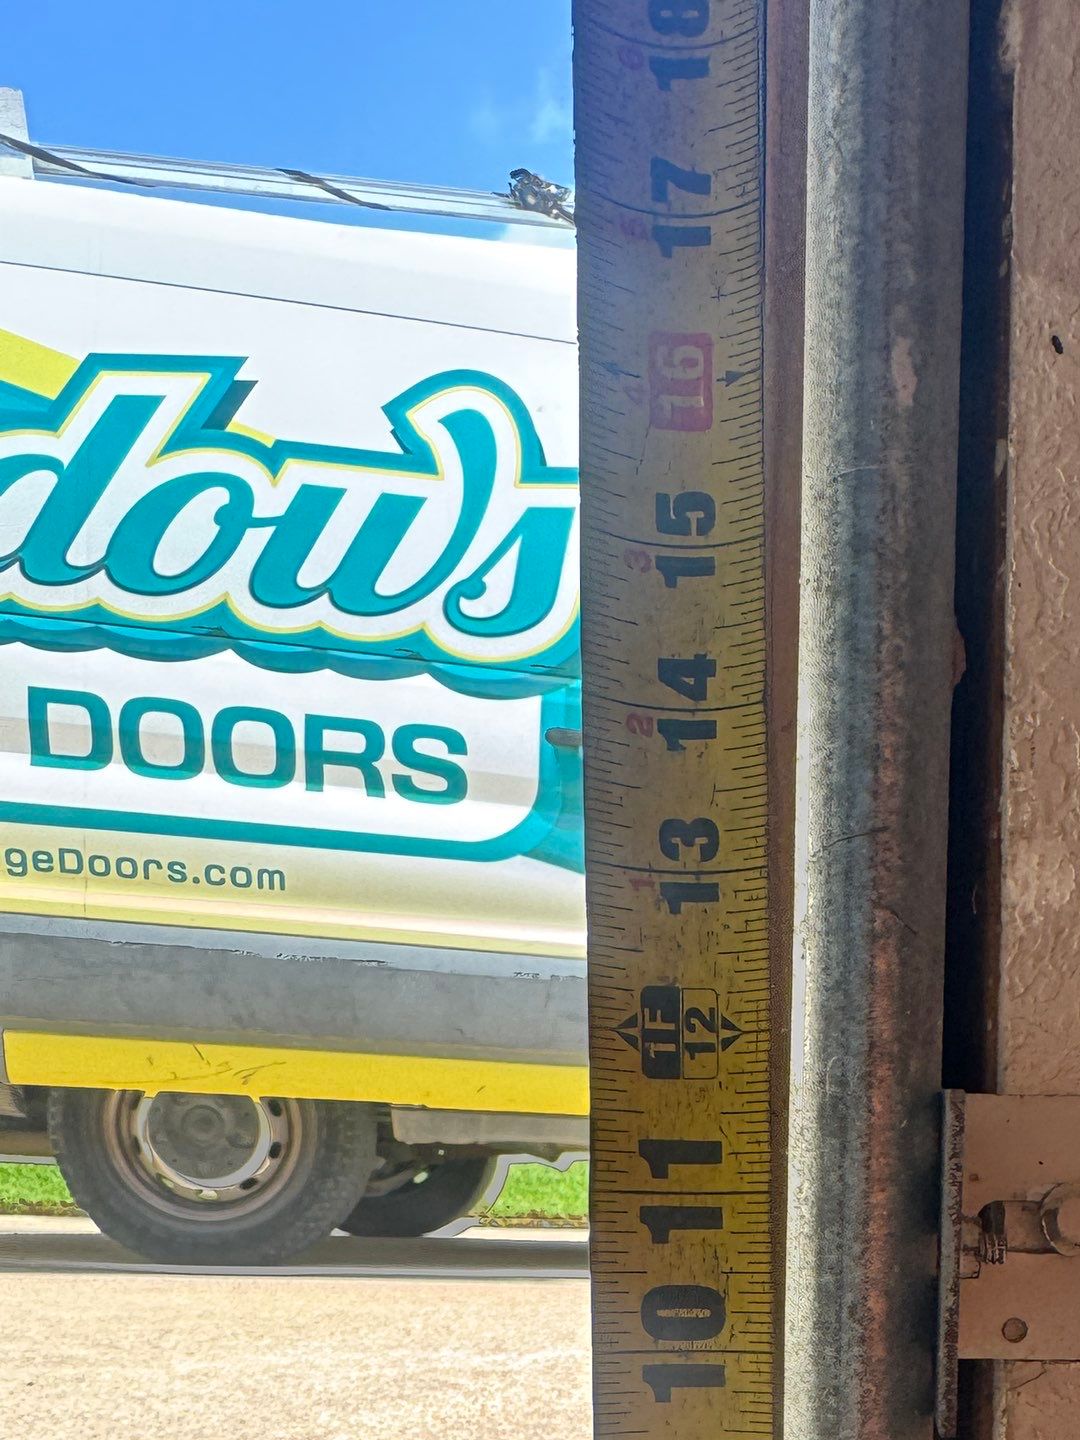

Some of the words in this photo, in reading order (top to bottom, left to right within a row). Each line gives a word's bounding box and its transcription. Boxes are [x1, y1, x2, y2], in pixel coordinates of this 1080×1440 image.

[647, 0, 711, 92] 18
[650, 155, 712, 259] 17
[655, 343, 706, 409] 16
[655, 491, 716, 588] 15
[27, 685, 469, 806] DOORS
[657, 653, 718, 752] 14
[4, 846, 286, 892] geDoors.com
[659, 817, 720, 915] 13
[683, 1007, 716, 1061] 12
[638, 1140, 724, 1244] 11
[640, 1285, 727, 1403] 10
